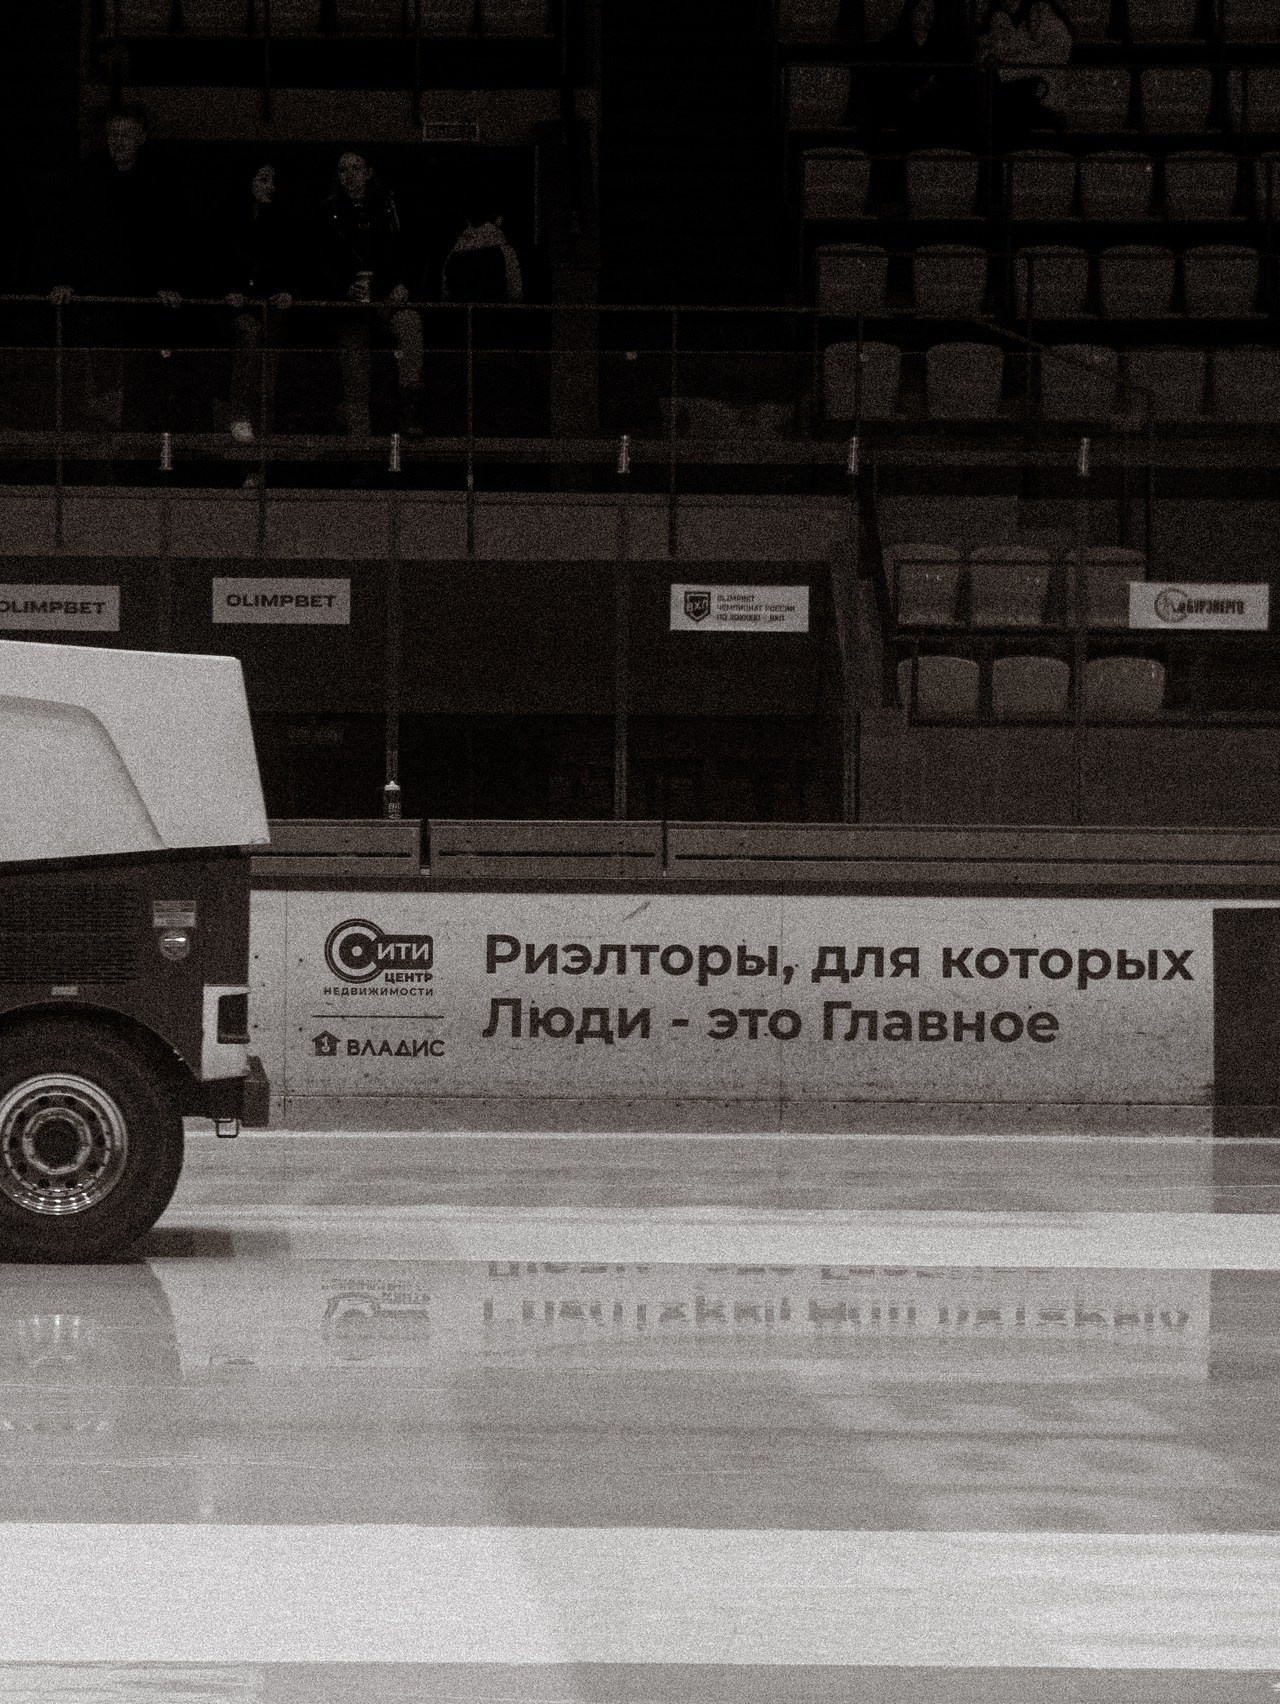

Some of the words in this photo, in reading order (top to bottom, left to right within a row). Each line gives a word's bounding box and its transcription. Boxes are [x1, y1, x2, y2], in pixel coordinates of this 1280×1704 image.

[226, 594, 337, 608] OLIMPBET
[486, 934, 796, 986] Риэлторы,
[811, 945, 920, 984] для
[941, 946, 1195, 990] которых
[384, 972, 434, 984] ЦЕНТР
[323, 986, 434, 997] НЕДВИЖИМОСТИ
[482, 997, 652, 1045] Люди
[706, 1008, 803, 1041] это
[822, 1000, 1061, 1044] Главное
[346, 1038, 446, 1057] ВЛАДИС
